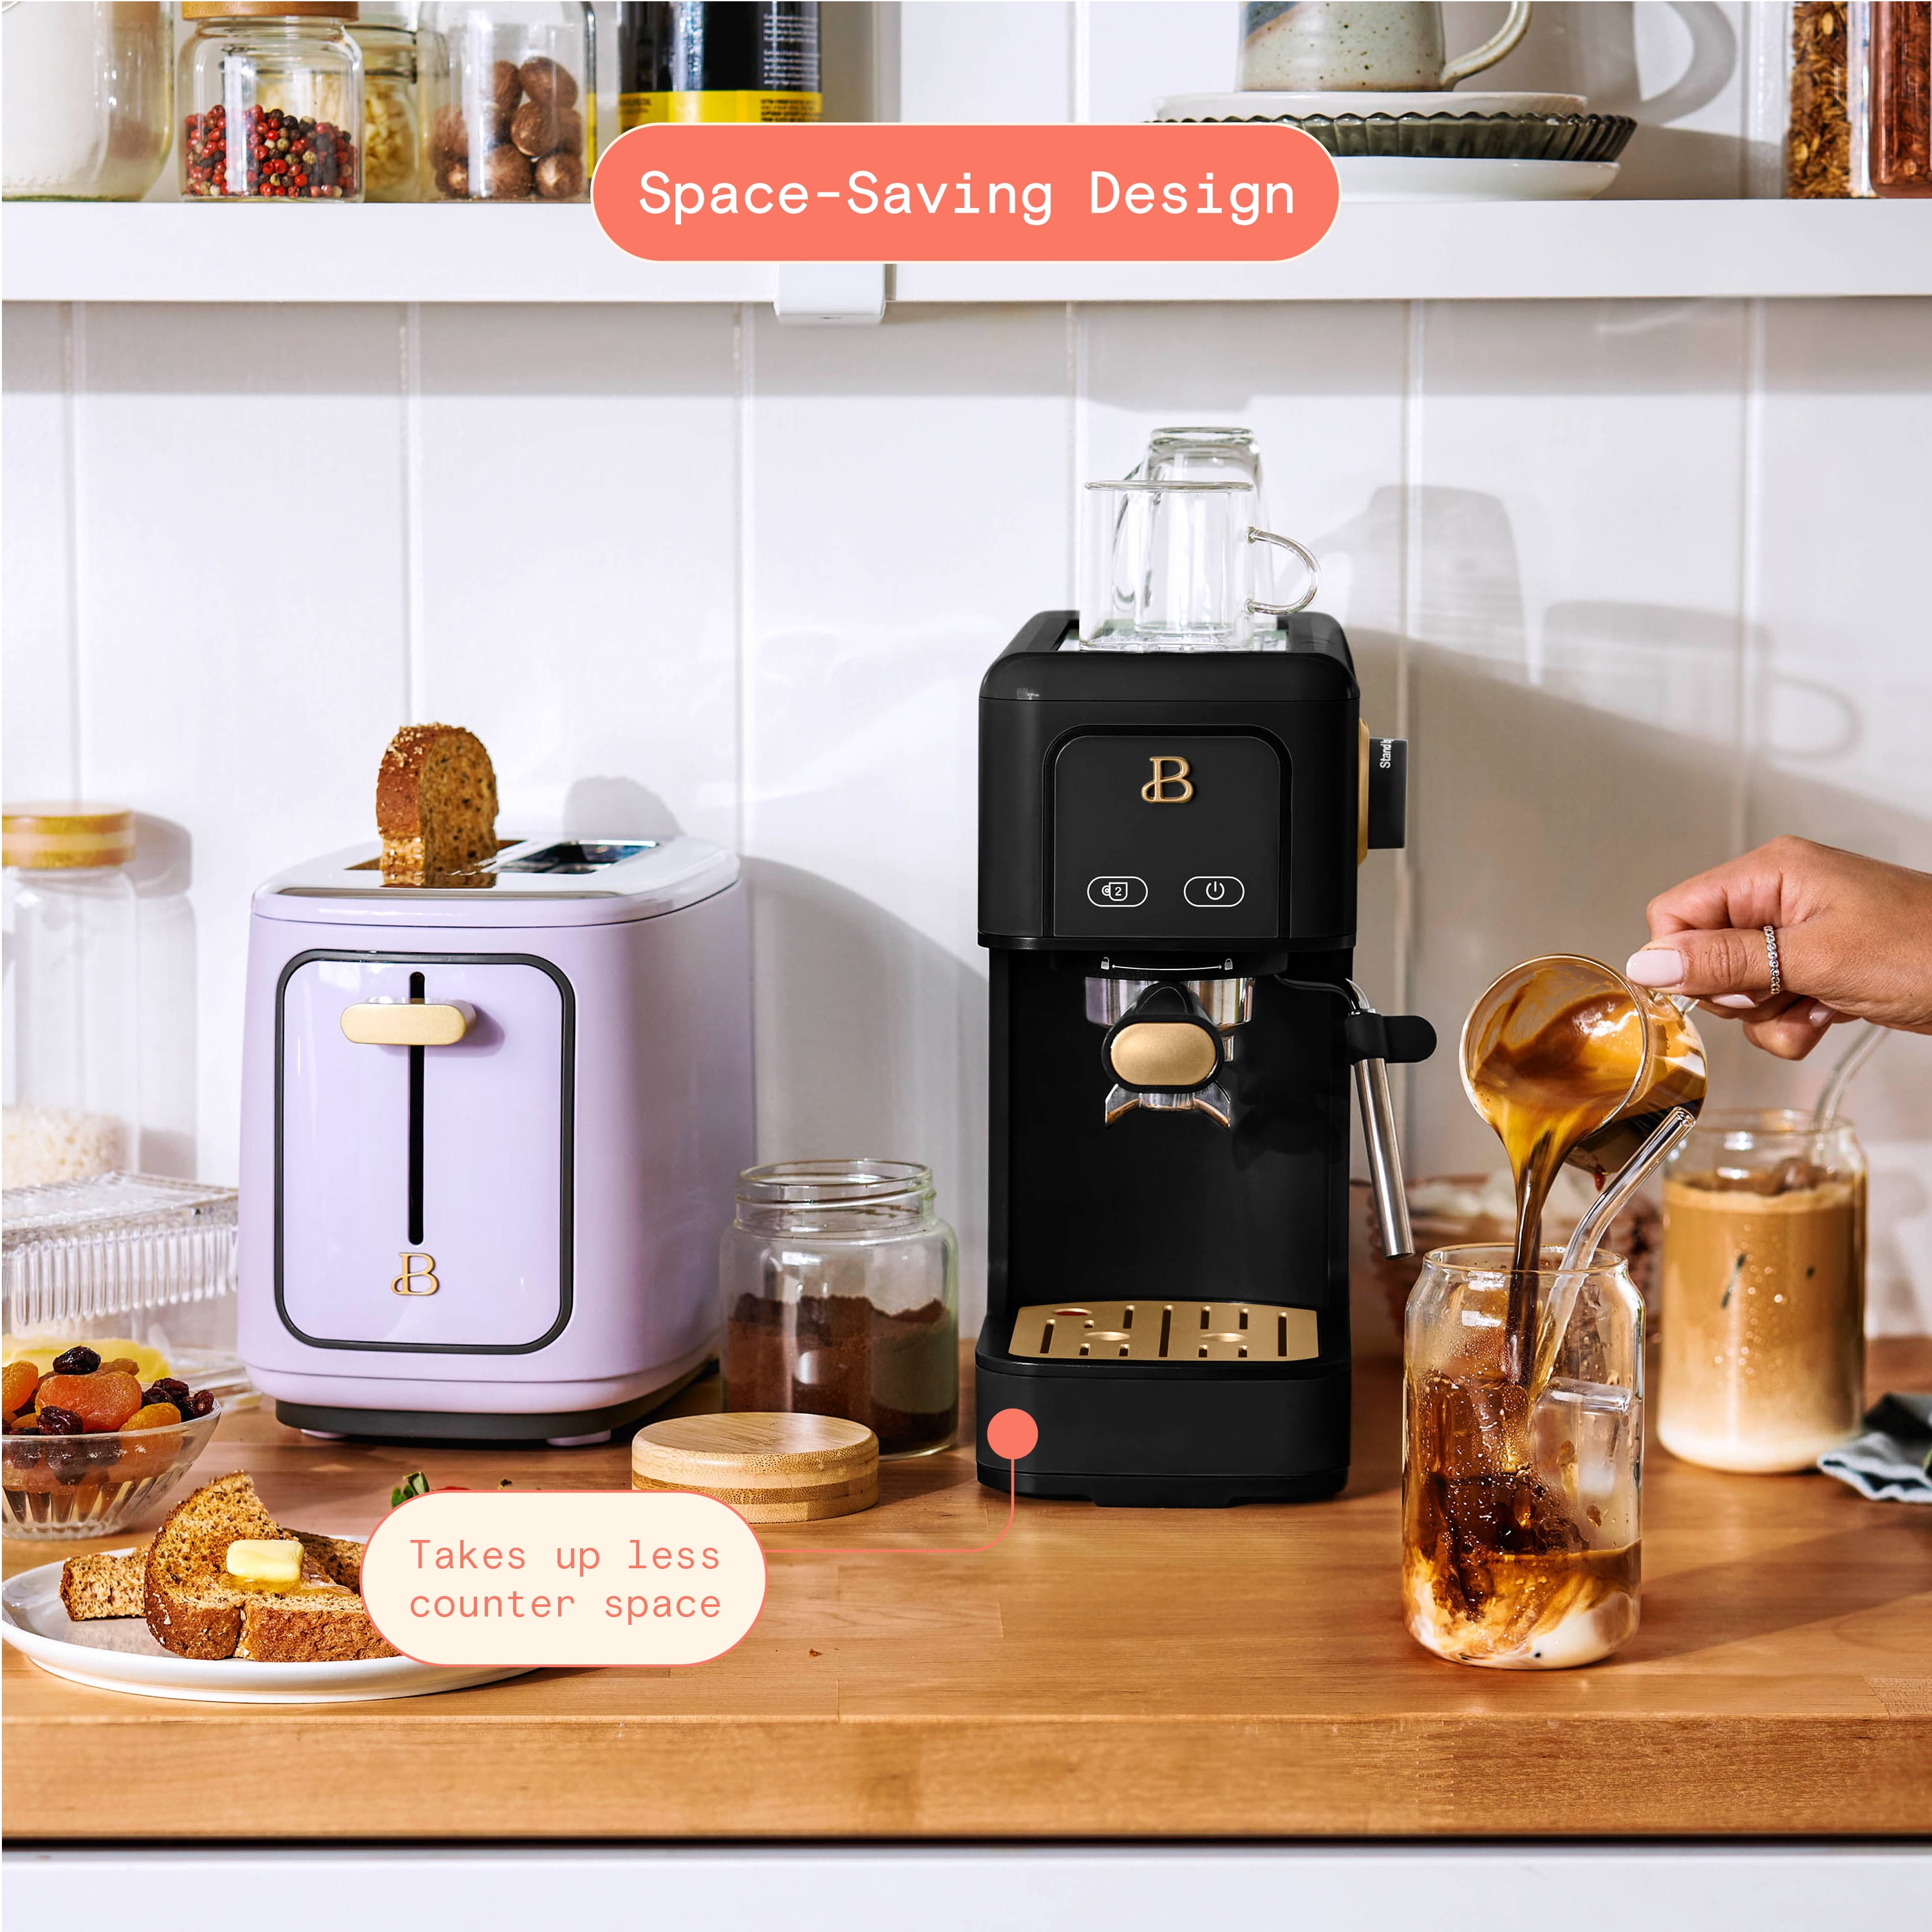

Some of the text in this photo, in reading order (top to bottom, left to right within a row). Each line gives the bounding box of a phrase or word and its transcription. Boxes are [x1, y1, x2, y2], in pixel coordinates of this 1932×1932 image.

[1141, 756, 1194, 803] B
[1114, 886, 1122, 896] 2
[391, 1252, 440, 1296] B
